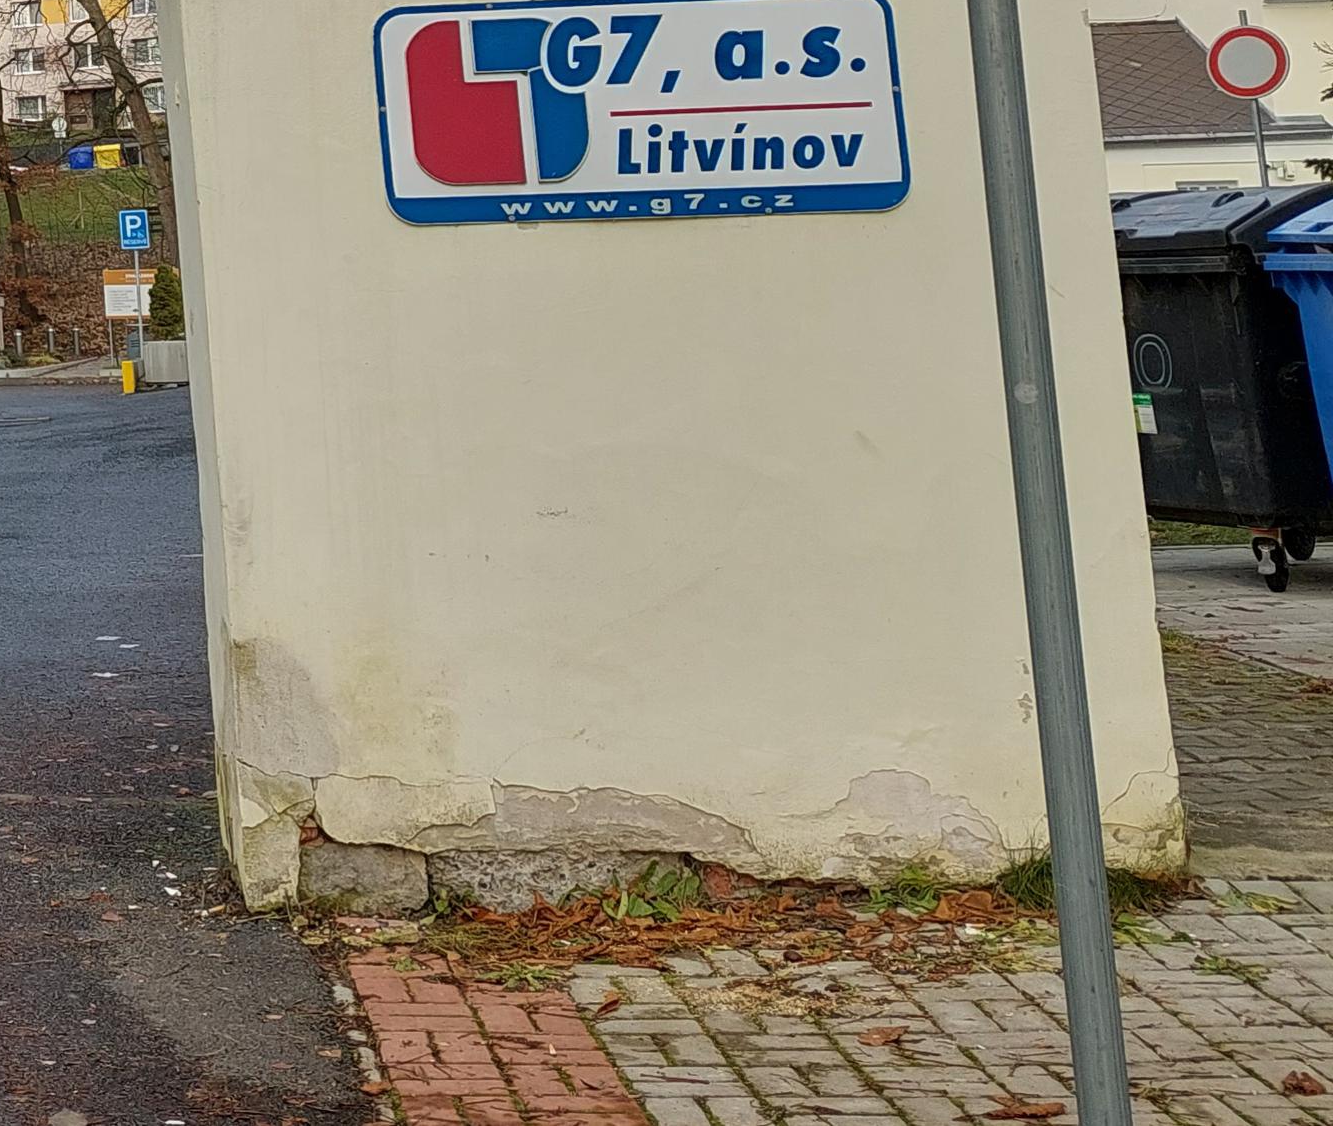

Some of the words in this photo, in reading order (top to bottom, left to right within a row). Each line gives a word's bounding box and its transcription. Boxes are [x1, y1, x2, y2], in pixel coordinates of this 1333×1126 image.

[714, 26, 868, 80] a.s.
[617, 123, 865, 175] Litvínov
[500, 192, 795, 215] www.g7.cz
[125, 215, 142, 238] P
